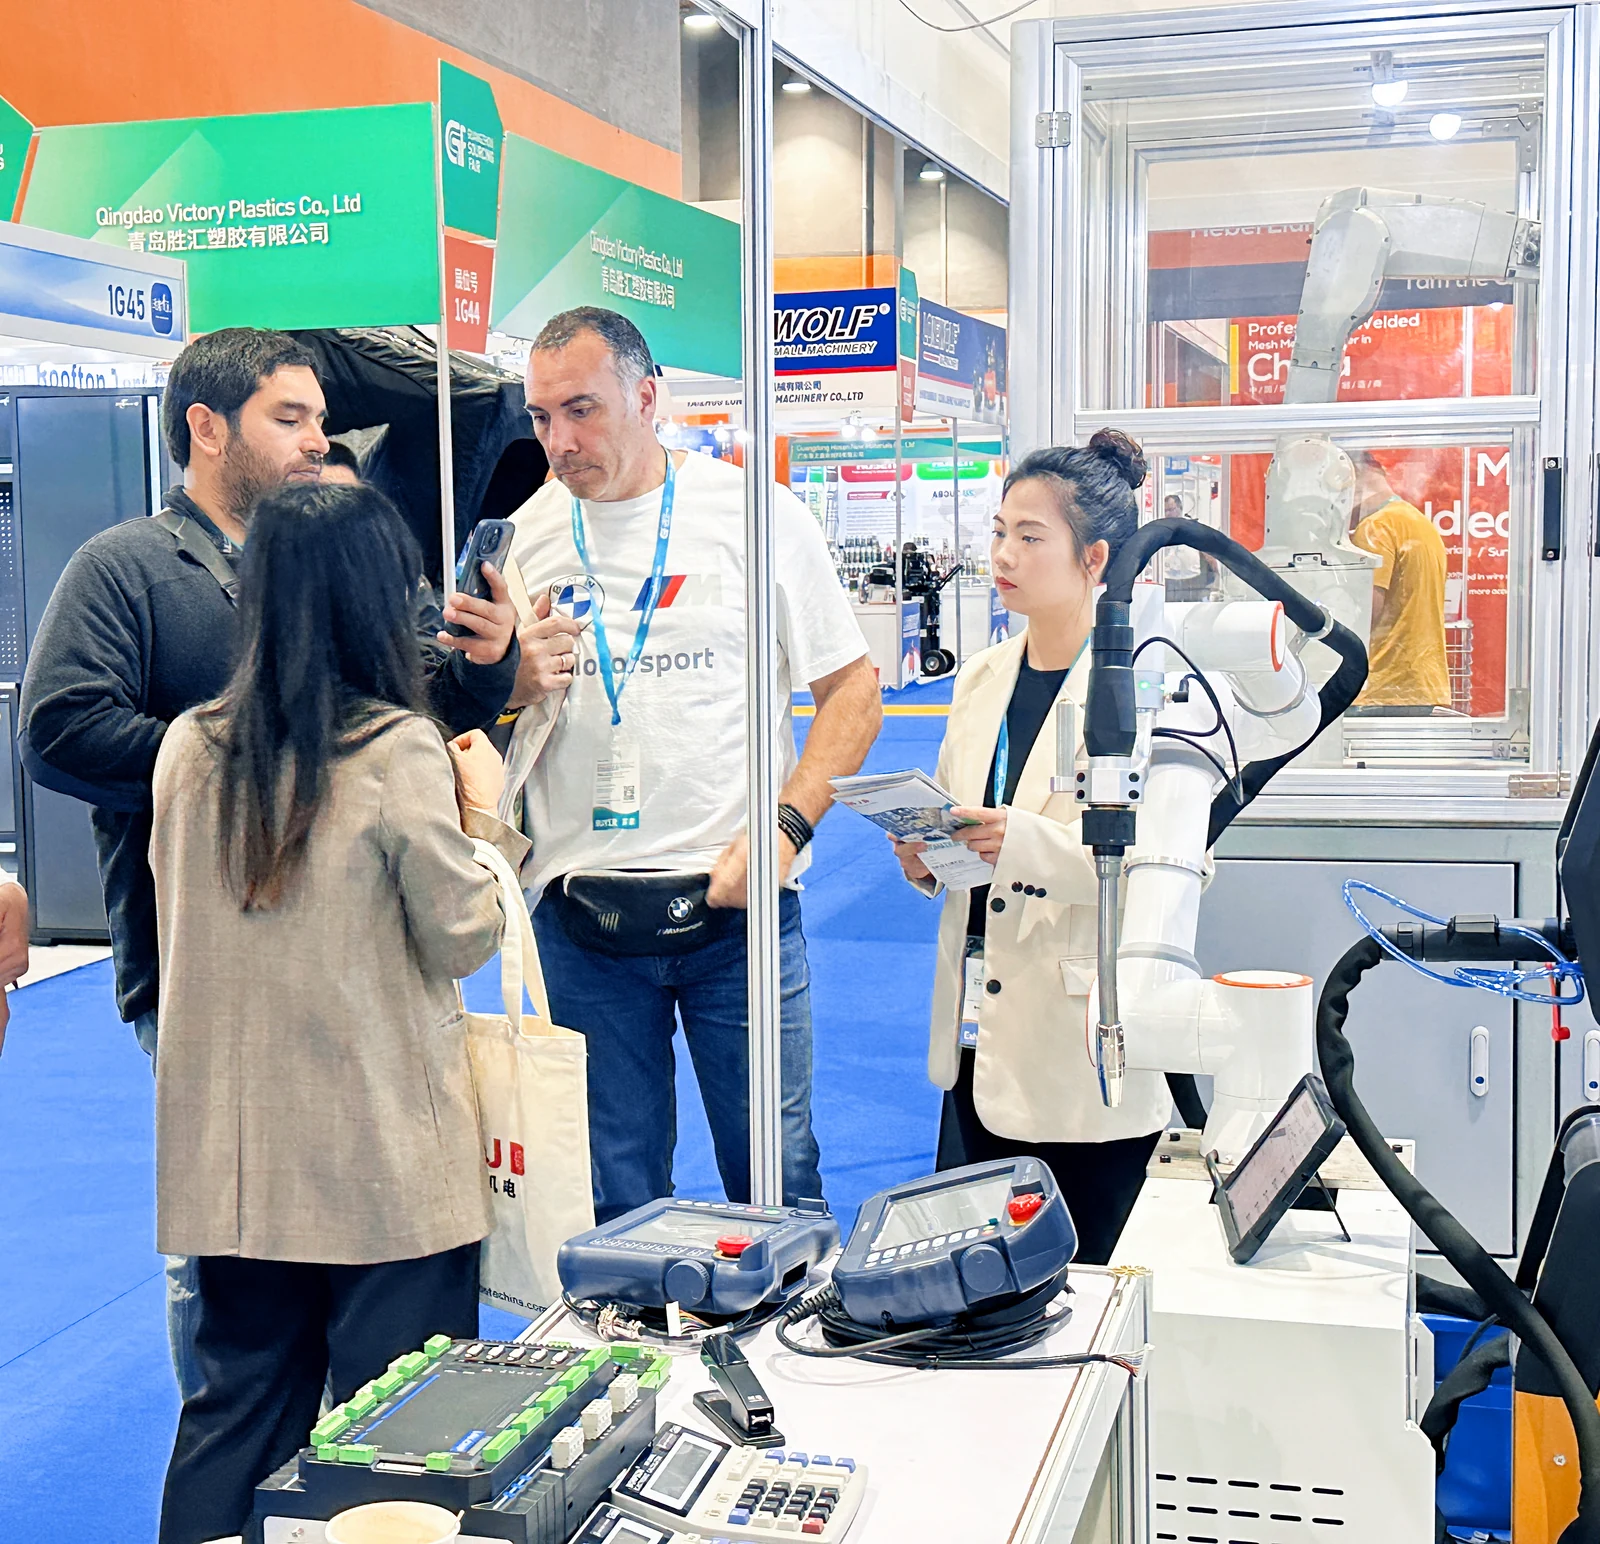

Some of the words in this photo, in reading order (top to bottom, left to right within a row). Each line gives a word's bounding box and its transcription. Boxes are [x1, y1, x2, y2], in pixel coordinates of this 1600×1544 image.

[95, 205, 164, 230] Qingdao
[166, 202, 226, 225] Victory
[228, 197, 296, 220] Plastics
[298, 195, 330, 218] Co.,
[333, 192, 362, 214] Ltd
[127, 222, 329, 253] 青岛胜汇塑胶有限公司
[107, 284, 146, 321] 1G45
[455, 297, 481, 326] 1G44
[806, 342, 876, 355] MACHINERY
[1248, 339, 1278, 351] Mesh
[775, 392, 829, 404] MACHINERY
